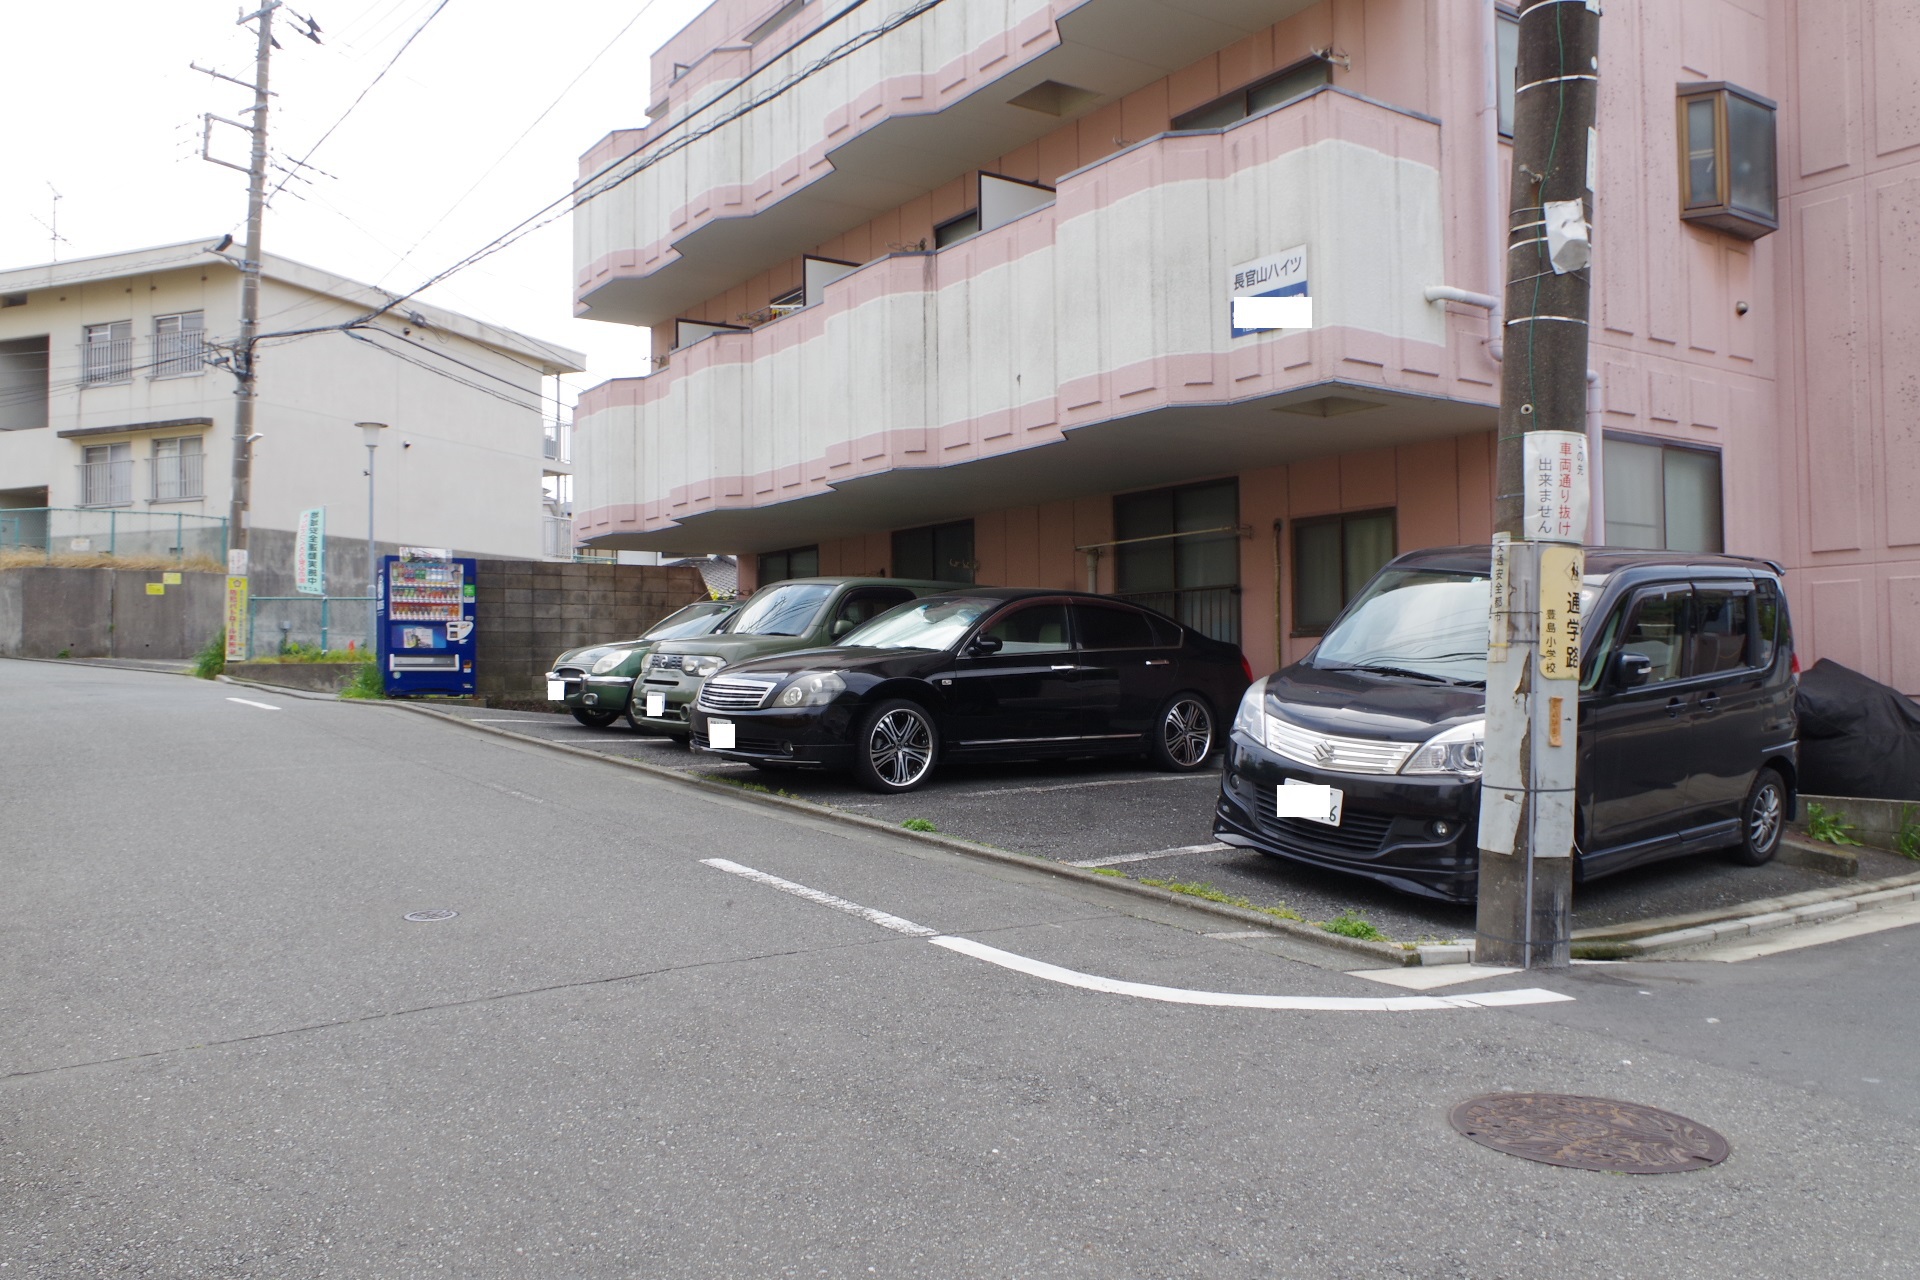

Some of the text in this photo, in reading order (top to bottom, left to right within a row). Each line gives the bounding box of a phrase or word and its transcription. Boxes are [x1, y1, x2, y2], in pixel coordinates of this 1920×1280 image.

[1233, 256, 1302, 291] 長官山ハイツ
[1538, 457, 1553, 534] 出来ません
[1558, 441, 1573, 537] 車両通り抜け
[1493, 540, 1504, 622] 交通安全都市
[1545, 609, 1557, 674] 豊島小学校
[1566, 592, 1580, 669] 通学路
